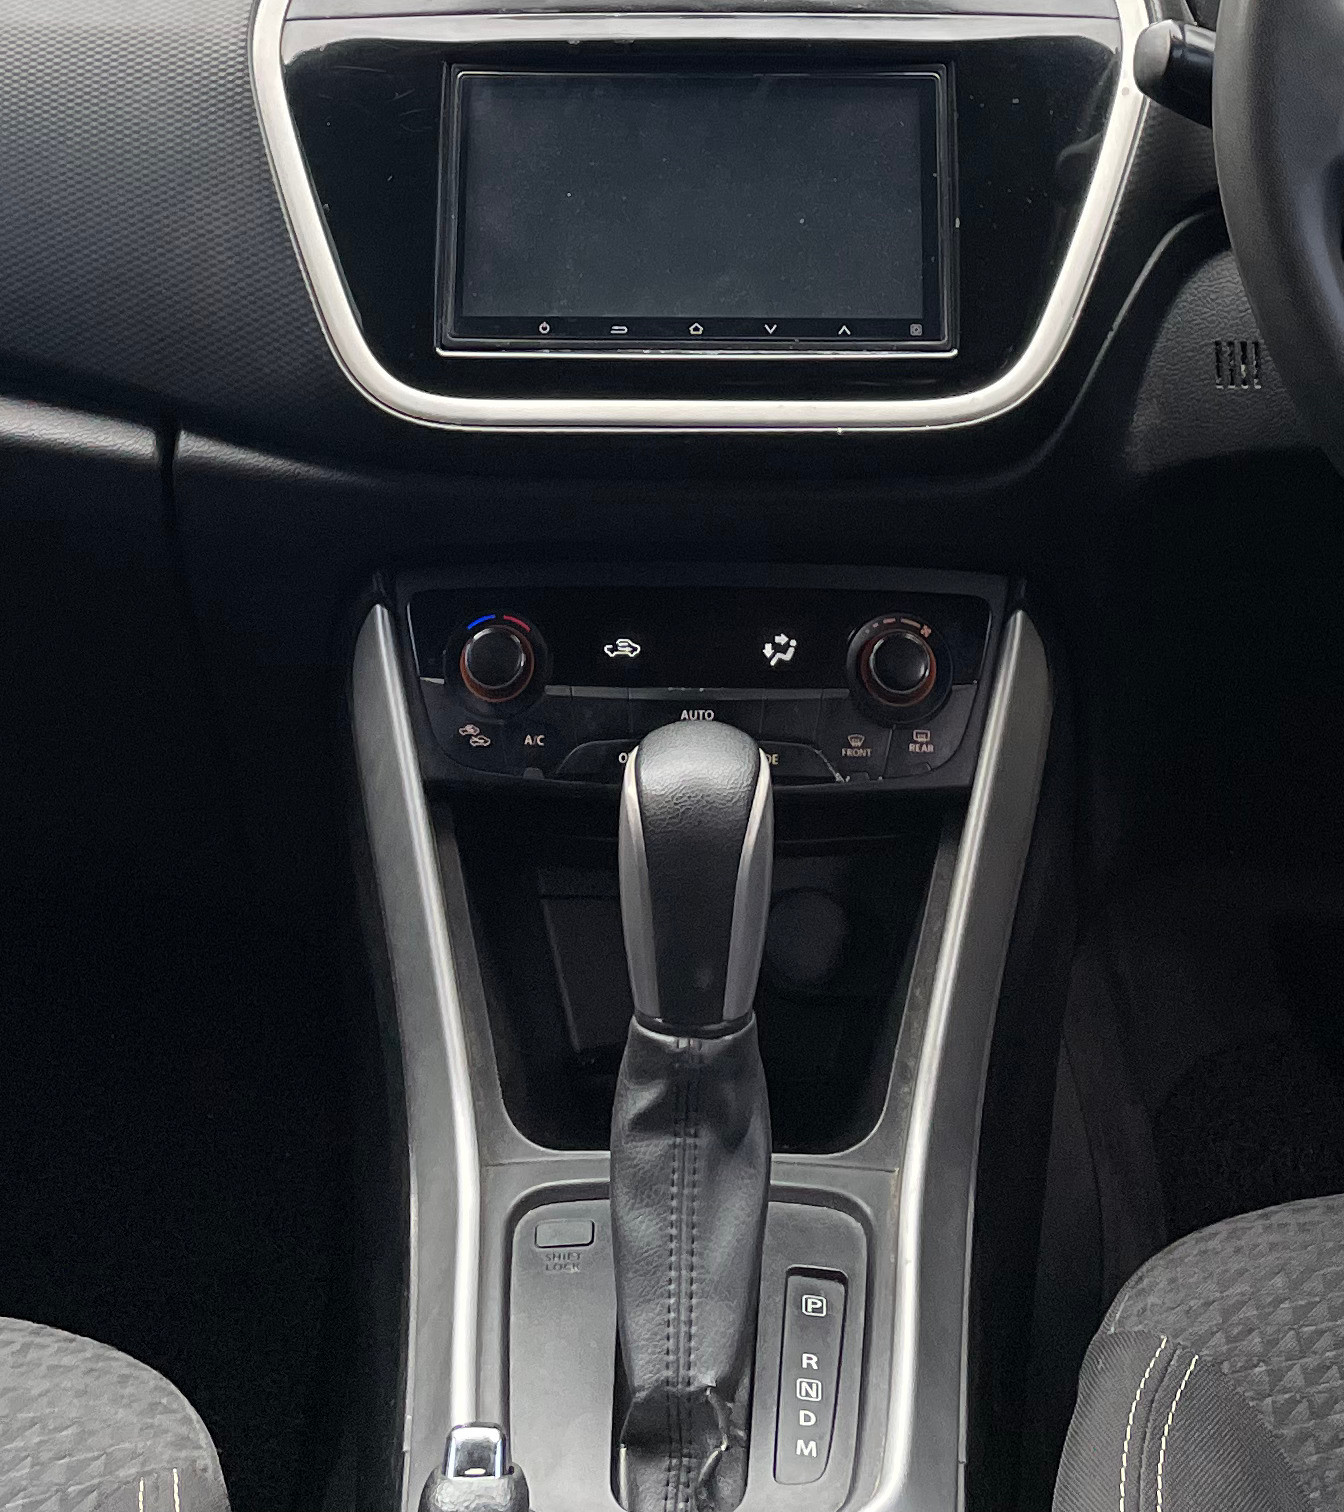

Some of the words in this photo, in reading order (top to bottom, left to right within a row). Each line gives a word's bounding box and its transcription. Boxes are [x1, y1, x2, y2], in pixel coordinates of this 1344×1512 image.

[680, 709, 715, 721] AUTO
[524, 734, 545, 746] A/C
[909, 743, 934, 753] REAR
[841, 747, 873, 758] FRONT
[806, 1298, 823, 1314] P
[801, 1353, 819, 1370] R
[800, 1381, 817, 1398] N
[799, 1409, 817, 1427] D
[795, 1439, 817, 1458] M
